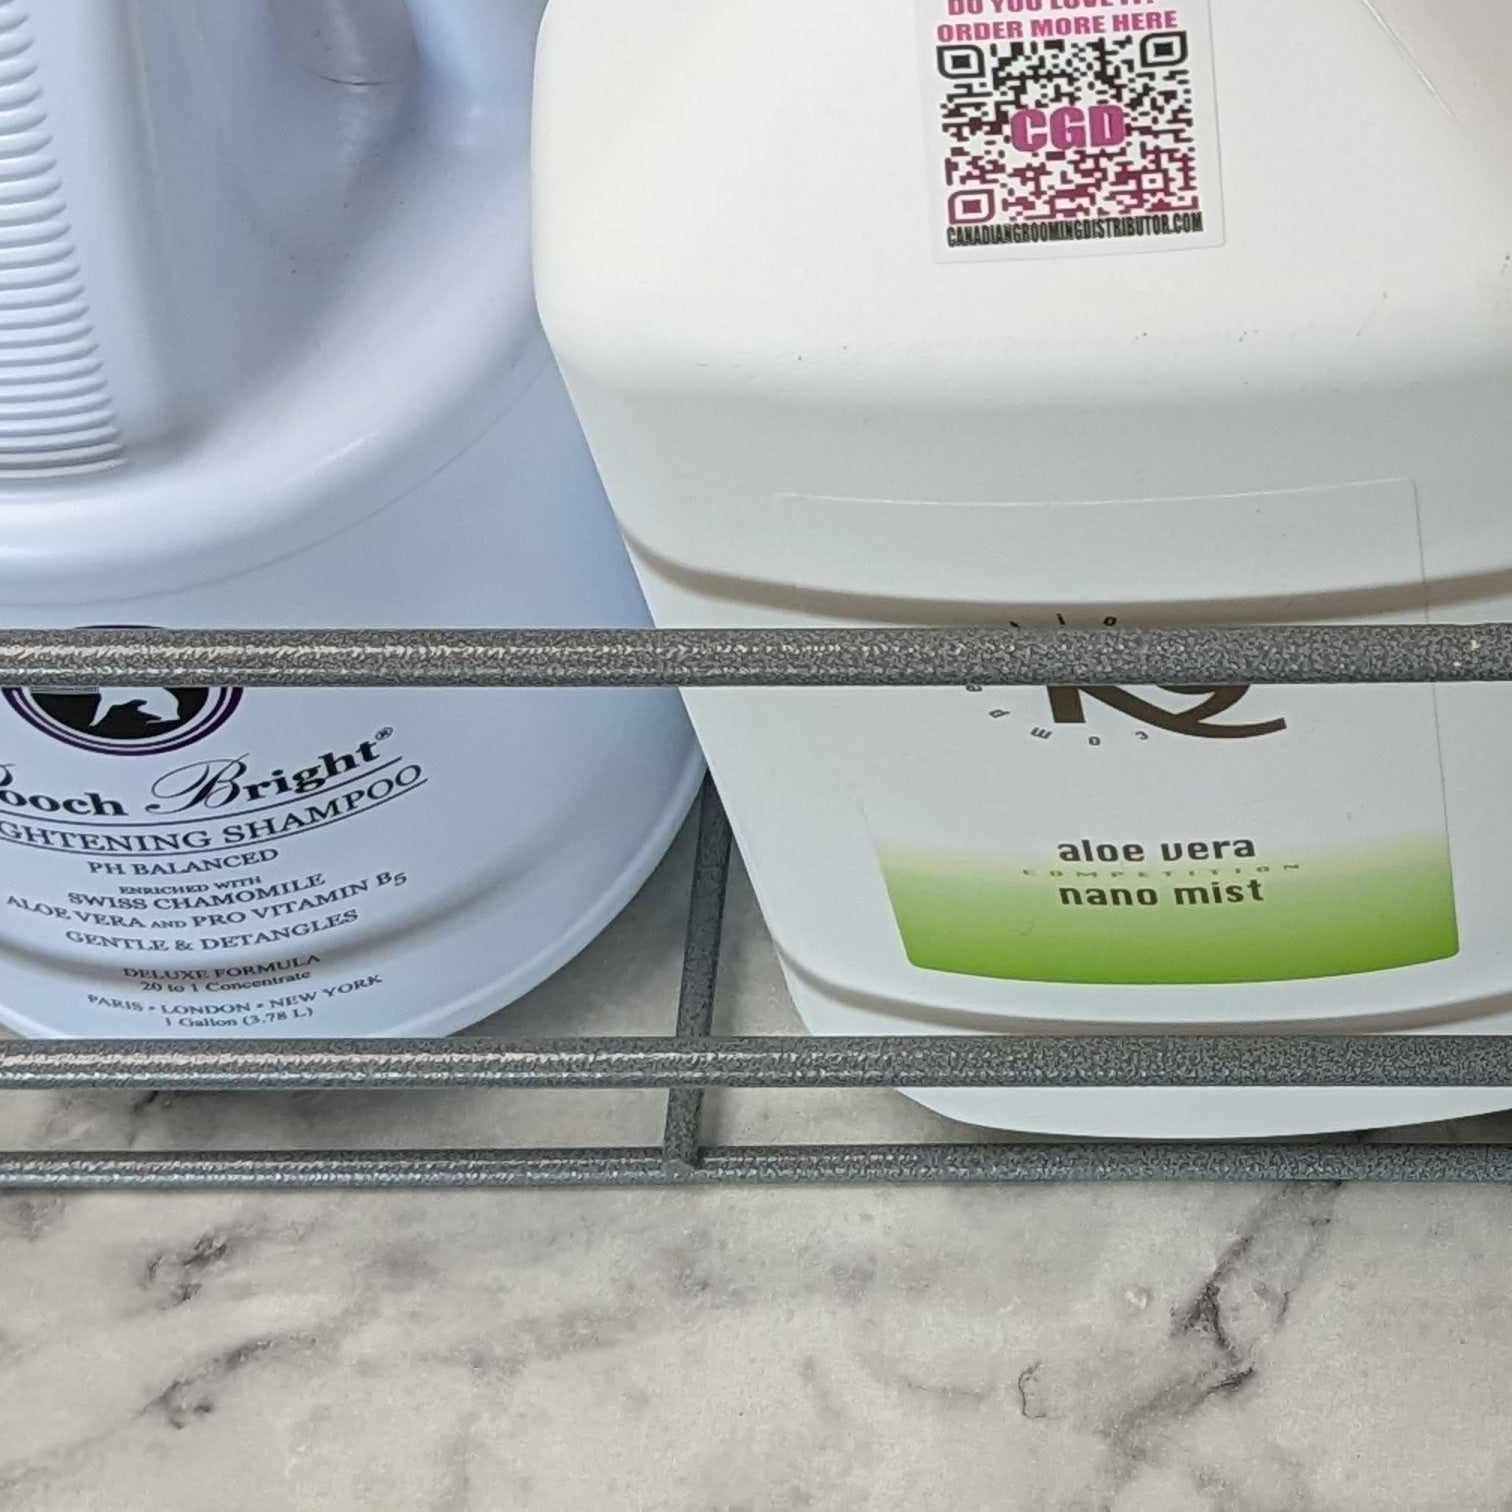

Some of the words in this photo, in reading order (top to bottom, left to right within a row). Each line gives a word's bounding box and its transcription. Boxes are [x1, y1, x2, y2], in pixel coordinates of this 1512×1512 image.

[937, 20, 1024, 42] ORDER
[1030, 15, 1105, 38] MORE
[1113, 10, 1178, 31] HERE
[1010, 104, 1127, 152] CGD
[947, 211, 1204, 247] CANADIANGROOMINGDISTRIBUTOR.COM
[224, 764, 422, 845] SHAMPOO
[88, 861, 126, 876] PH
[135, 849, 279, 876] BALANCED
[1057, 839, 1145, 862] aloe
[1160, 838, 1256, 862] vera
[67, 891, 148, 910] SWISS
[154, 872, 326, 910] CHAMOMILE
[120, 883, 209, 896] ENRICHED
[215, 875, 261, 891] WITH
[1058, 886, 1158, 906] nano
[1174, 879, 1264, 905] mist
[6, 895, 71, 920] ALOE
[72, 911, 146, 928] VERA
[152, 918, 187, 929] AND
[193, 911, 246, 929] PRO
[250, 879, 370, 920] VITAMIN
[66, 930, 168, 951] GENTLE
[175, 939, 193, 952] &
[201, 908, 359, 951] DETANGLES
[123, 966, 211, 981] DELUXE
[214, 954, 321, 979] FORMULA
[206, 970, 312, 992] Concentrate
[88, 994, 144, 1013] PARIS
[162, 1001, 250, 1015] LONDON
[270, 991, 318, 1009] NEW
[322, 974, 384, 998] YORK
[178, 1016, 239, 1027] Gallon
